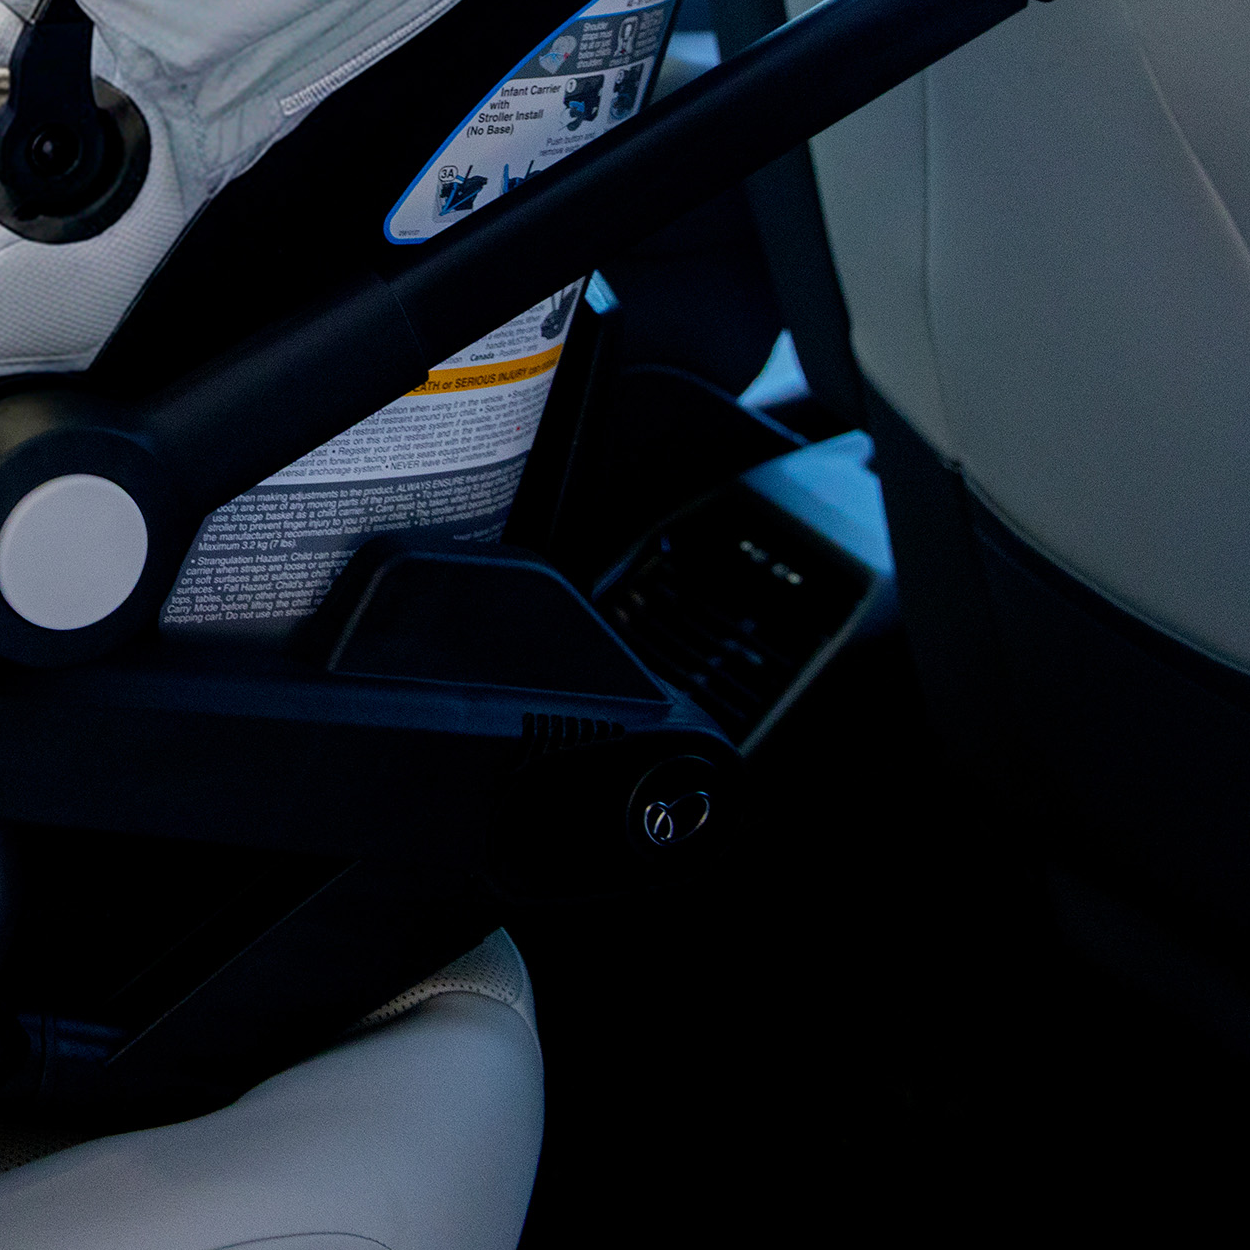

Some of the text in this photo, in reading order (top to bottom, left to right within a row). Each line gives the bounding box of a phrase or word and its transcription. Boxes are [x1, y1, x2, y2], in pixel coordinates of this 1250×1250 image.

[501, 84, 561, 97] Infant Carrier
[490, 100, 510, 110] with
[478, 109, 544, 123] Stroller Install
[467, 124, 514, 138] (No Base)
[546, 135, 583, 147] Push button
[441, 169, 454, 180] 3A
[470, 352, 495, 361] Canada
[442, 379, 453, 389] or
[455, 373, 497, 389] SERIOUS
[498, 367, 527, 382] INJURY
[410, 405, 430, 413] when
[432, 402, 451, 411] using
[380, 415, 412, 424] restraint
[414, 412, 440, 422] around
[442, 413, 459, 421] your
[353, 425, 384, 435] restraint
[387, 424, 427, 432] anchorage
[429, 420, 454, 431] system
[367, 436, 380, 444] this
[383, 434, 402, 443] child
[404, 431, 434, 441] restraint
[437, 429, 451, 438] and
[338, 436, 472, 456] Register your child restraint with the
[330, 455, 362, 465] forward-
[364, 454, 386, 463] facing
[388, 452, 414, 461] vehicle
[417, 450, 436, 459] seats
[438, 444, 470, 457] equipped
[309, 456, 459, 476] anchorage system. NEVER leave child
[257, 475, 465, 502] making adjustments to the product. ALWAYS ENSURE
[217, 504, 239, 514] body
[256, 503, 278, 511] clear
[279, 502, 288, 510] of
[289, 502, 306, 510] any
[307, 499, 337, 509] moving
[338, 498, 358, 509] parts
[360, 496, 369, 505] of
[370, 496, 383, 504] the
[384, 493, 413, 505] product.
[231, 513, 263, 522] storage
[266, 511, 294, 520] basket
[317, 509, 337, 517] child
[338, 507, 364, 516] carrier.
[375, 505, 394, 513] Care
[396, 502, 415, 511] must
[207, 523, 238, 532] stroller
[239, 523, 249, 531] to
[250, 521, 282, 532] prevent
[283, 520, 308, 530] finger
[309, 519, 331, 529] injury
[332, 517, 342, 525] to
[343, 517, 360, 526] you
[370, 515, 387, 524] your
[219, 530, 282, 541] manufacturer's
[284, 526, 342, 537] recommended
[344, 525, 362, 533] load
[198, 539, 297, 551] Maximum 3.2 kg (7 lbs).
[197, 555, 253, 566] Strangulation
[256, 553, 288, 562] Hazard:
[291, 552, 312, 561] Child
[186, 566, 214, 575] carrier
[216, 565, 239, 573] when
[240, 565, 267, 574] straps
[283, 563, 306, 571] loose
[195, 576, 211, 584] soft
[214, 575, 250, 583] surfaces
[252, 573, 269, 582] and
[271, 572, 309, 581] suffocate
[177, 581, 304, 594] surfaces. Fall Hazard: Child's
[171, 596, 192, 605] tops,
[195, 594, 222, 604] tables,
[237, 594, 253, 602] any
[254, 592, 277, 600] other
[279, 589, 314, 599] elevated
[167, 605, 191, 614] Carry
[194, 604, 218, 612] Mode
[221, 603, 248, 611] before
[251, 601, 273, 611] lifting
[275, 600, 290, 608] the
[291, 598, 312, 607] child
[164, 613, 203, 624] shopping
[204, 612, 223, 621] cart.
[226, 612, 238, 620] Do
[240, 611, 254, 619] not
